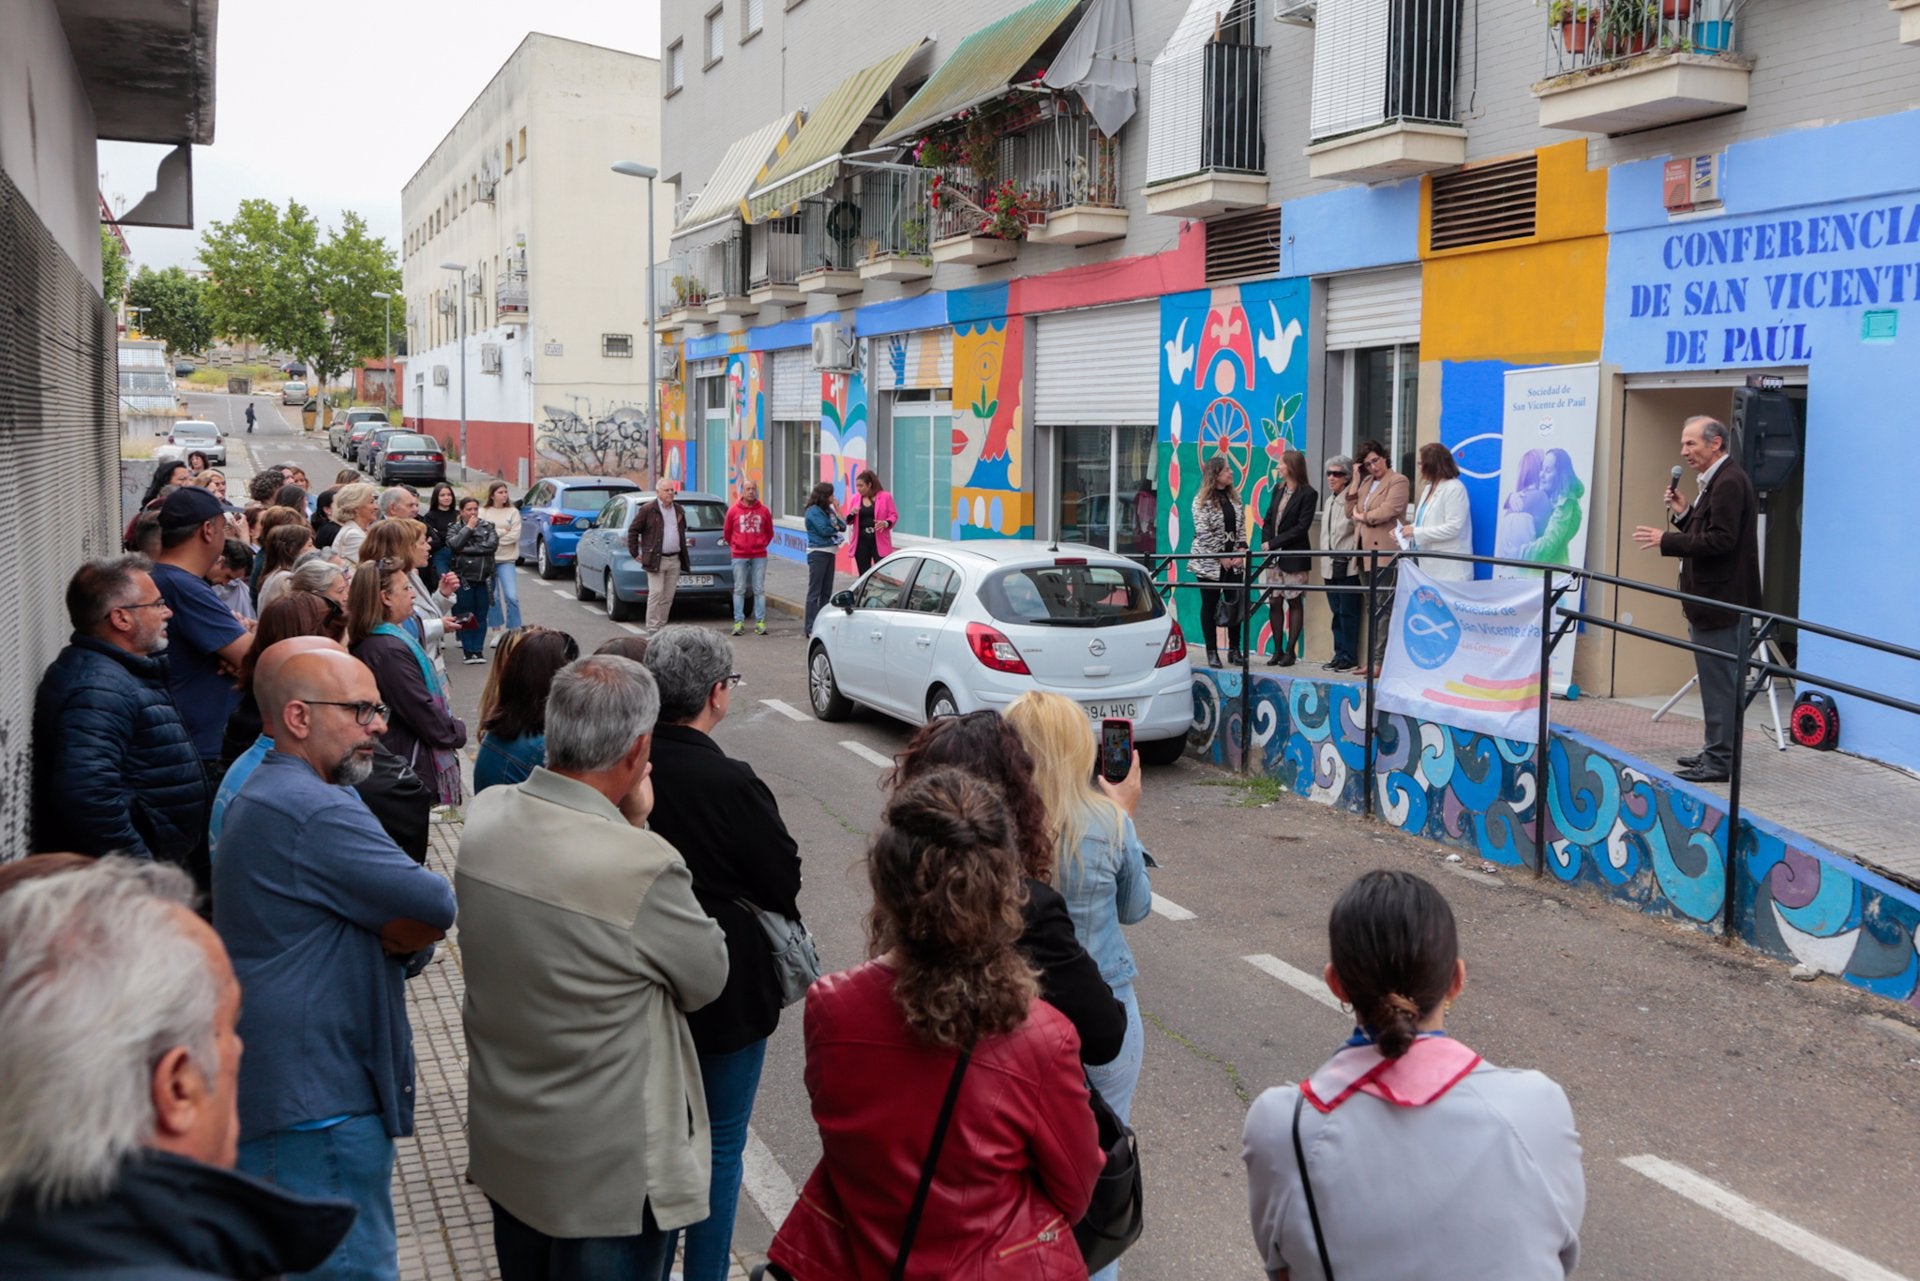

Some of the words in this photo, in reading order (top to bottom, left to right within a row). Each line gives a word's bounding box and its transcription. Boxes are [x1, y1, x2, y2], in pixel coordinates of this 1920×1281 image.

[1630, 283, 1672, 318] DE
[1684, 277, 1749, 316] SAN
[1665, 330, 1708, 364] DE
[1722, 318, 1812, 363] PAÚL
[1528, 386, 1560, 397] Sociedad
[1561, 385, 1571, 393] de
[1513, 403, 1525, 411] San
[1528, 400, 1555, 411] Vicente
[1556, 399, 1566, 408] de
[1478, 623, 1520, 637] Vicente
[1110, 703, 1136, 717] HVG
